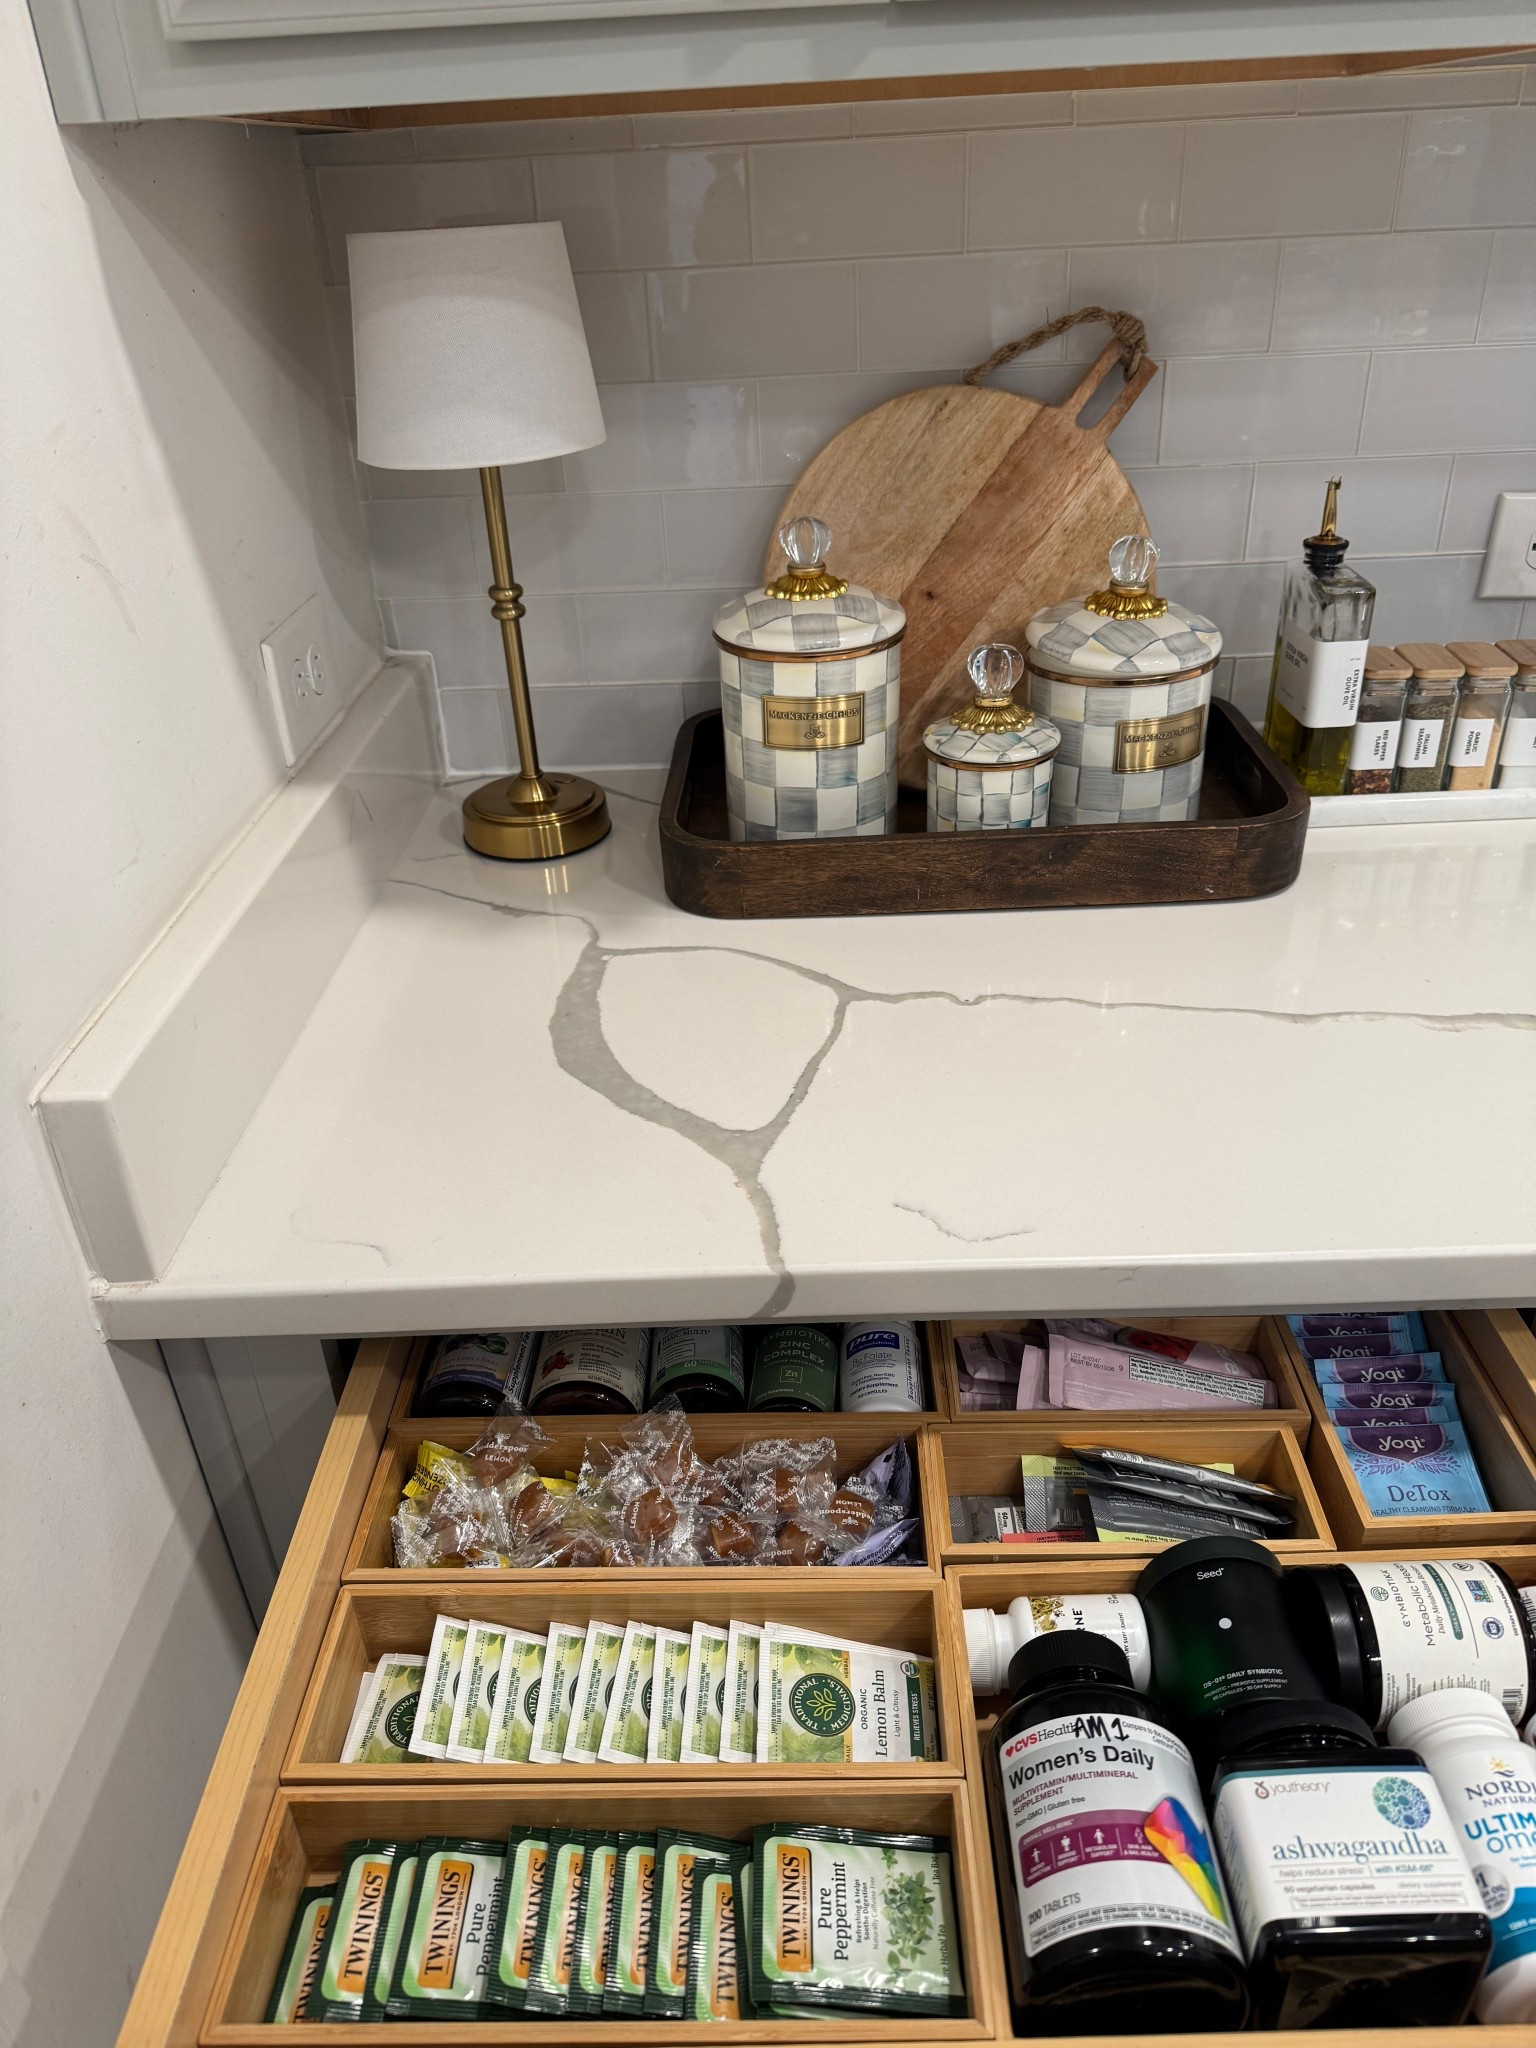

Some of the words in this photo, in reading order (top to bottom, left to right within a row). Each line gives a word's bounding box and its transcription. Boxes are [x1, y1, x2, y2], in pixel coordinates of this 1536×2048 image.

[1344, 677, 1352, 694] OLIVE
[1352, 669, 1360, 688] EXTRA
[1348, 689, 1357, 711] VIRGIN
[1373, 735, 1381, 756] FLAKES
[1379, 741, 1388, 761] PEPPER
[1413, 727, 1425, 761] SEASONING
[1421, 733, 1431, 755] ITALIAN
[1464, 730, 1474, 755] POWDER
[1471, 731, 1481, 753] GARLIC
[769, 1329, 832, 1350] YMBIOTIKA
[779, 1340, 811, 1350] ZINC
[849, 1332, 896, 1352] pure
[684, 1360, 697, 1368] 60
[763, 1349, 825, 1366] COMPLEX
[863, 1351, 893, 1362] Folate
[1070, 1357, 1085, 1366] BEST
[508, 1345, 527, 1394] Supplement
[784, 1369, 798, 1378] Zn
[906, 1359, 915, 1400] Supplement
[849, 1385, 866, 1398] Dietary
[865, 1381, 899, 1389] Supplement
[484, 1454, 513, 1464] LEMON
[835, 1499, 862, 1507] LEMON
[1386, 1485, 1452, 1502] DeTox
[630, 1501, 640, 1529] LEMON
[1001, 1511, 1008, 1520] 60
[1371, 1506, 1401, 1516] HEALTHY
[1402, 1505, 1442, 1514] CLEANSING
[1197, 1568, 1222, 1581] Seed
[1393, 1562, 1415, 1584] Health
[1423, 1584, 1441, 1614] Metabolism
[1496, 1585, 1516, 1614] SUPPLEMENT
[1411, 1585, 1436, 1647] Metabolic
[1436, 1616, 1446, 1634] Daily
[1508, 1614, 1519, 1636] DIETARY
[1226, 1670, 1246, 1680] DAILY
[1246, 1668, 1284, 1676] SYNBIOTIC
[504, 1680, 514, 1714] EVIDENT-MOISTURE
[872, 1669, 886, 1704] Balm
[1219, 1688, 1244, 1699] CAPSULES
[795, 1678, 819, 1731] TRADITIONAL
[830, 1680, 852, 1731] MEDICINALS
[860, 1688, 868, 1730] ORGANIC
[892, 1689, 900, 1712] Citrusy
[911, 1693, 919, 1714] STRESS
[875, 1707, 888, 1757] Lemon
[913, 1714, 921, 1741] RELIEVES
[1074, 1715, 1112, 1742] AM
[1111, 1717, 1130, 1742] 1
[1008, 1746, 1097, 1790] Women's
[1103, 1744, 1155, 1771] Daily
[1012, 1770, 1139, 1807] MULTIVITAMIN/MULTIMINERAL
[1269, 1780, 1330, 1798] youtheory
[1013, 1786, 1065, 1817] SUPPLEMENT
[1015, 1809, 1044, 1829] Non-GMO
[1047, 1799, 1071, 1812] Gluten
[1071, 1795, 1087, 1805] free
[1272, 1831, 1450, 1865] ashwagandha
[931, 1868, 941, 1881] Tea
[1278, 1867, 1303, 1879] helps
[1304, 1866, 1336, 1877] reduce
[1374, 1864, 1394, 1874] with
[854, 1878, 862, 1898] Helps
[862, 1881, 871, 1917] Digestion
[870, 1875, 879, 1919] Caffeine-Free
[1296, 1883, 1339, 1894] vegetarian
[1339, 1882, 1376, 1892] capsules
[455, 1890, 465, 1921] LONDON
[519, 1857, 547, 1966] TWININGS
[782, 1852, 801, 1958] TWININGS
[817, 1887, 833, 1930] Pure
[831, 1861, 852, 1961] Peppermint
[856, 1896, 862, 1904] &
[1028, 1910, 1042, 1926] 200
[1040, 1891, 1082, 1916] TABLETS
[343, 1871, 384, 1978] TWININGS
[424, 1868, 461, 1976] TWININGS
[466, 1902, 486, 1945] Pure
[676, 1863, 696, 1973] TWININGS
[855, 1903, 864, 1944] Refreshing
[863, 1918, 871, 1940] Soothe
[937, 1923, 948, 1936] Tea
[871, 1918, 881, 1950] Naturally
[716, 1891, 736, 2004] TWININGS
[938, 1936, 949, 1964] Herbal
